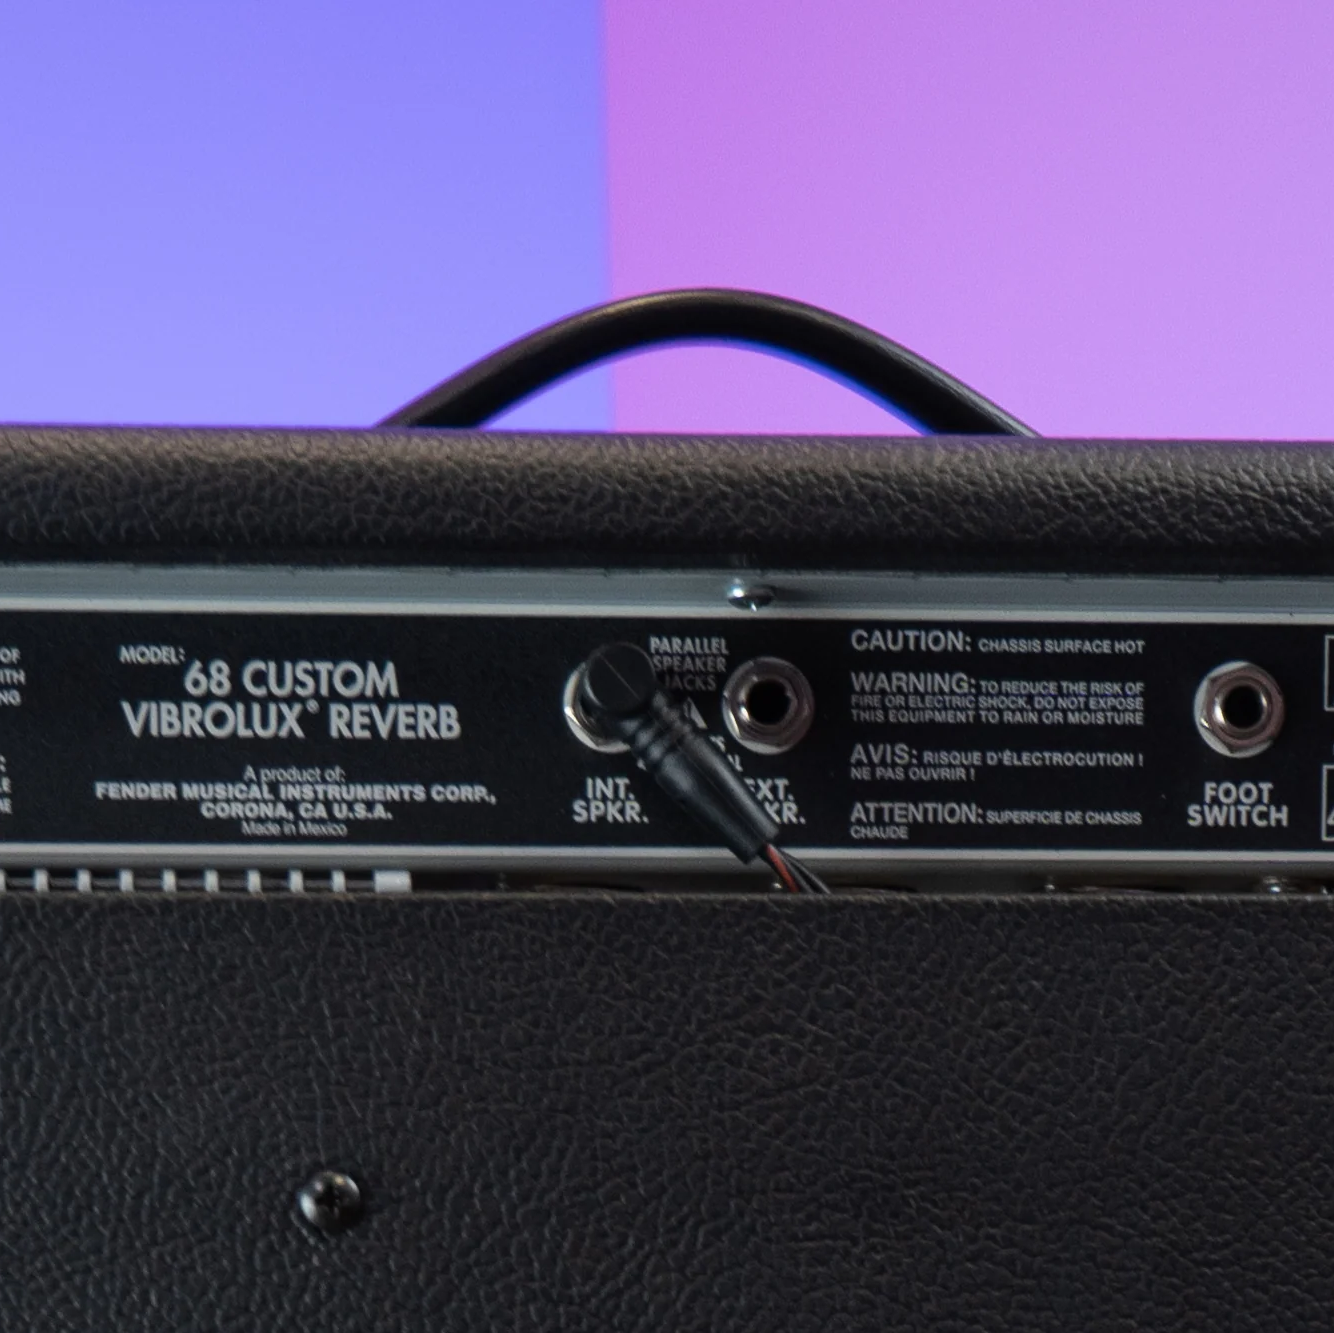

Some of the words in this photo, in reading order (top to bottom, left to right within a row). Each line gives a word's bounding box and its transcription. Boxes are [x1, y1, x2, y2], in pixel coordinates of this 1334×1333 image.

[649, 636, 728, 654] PARALLEL
[850, 629, 971, 652] CAUTION:
[978, 640, 1042, 653] CHASSIS
[1043, 640, 1112, 654] SURFACE
[1114, 641, 1145, 655] HOT
[119, 644, 186, 666] MODEL:
[651, 655, 727, 672] SPEAKER
[183, 660, 232, 698] 68
[242, 660, 400, 698] CUSTOM
[850, 671, 976, 694] WARNING:
[980, 681, 1000, 695] TO
[1001, 681, 1059, 695] REDUCE
[1060, 681, 1088, 695] THE
[1090, 681, 1123, 696] RISK
[1125, 682, 1145, 696] OF
[850, 694, 884, 708] FIRE
[885, 694, 906, 708] OR
[908, 695, 976, 709] ELECTRIC
[978, 695, 1032, 709] SHOCK,
[1034, 695, 1054, 709] DO
[1056, 696, 1087, 710] NOT
[1089, 696, 1144, 710] EXPOSE
[328, 701, 462, 739] REVERB
[850, 709, 885, 723] THIS
[886, 709, 976, 723] EQUIPMENT
[978, 709, 1000, 723] TO
[1003, 710, 1040, 724] RAIN
[1042, 710, 1064, 724] OR
[1066, 710, 1144, 724] MOISTURE
[850, 743, 918, 765] AVIS:
[923, 751, 982, 766] RISQUE
[243, 765, 258, 780] A
[259, 766, 318, 785] product
[324, 765, 348, 783] of:
[850, 767, 872, 780] NE
[875, 767, 905, 781] PAS
[908, 767, 966, 781] OUVRIR
[94, 781, 177, 800] FENDER
[181, 782, 274, 801] MUSICAL
[279, 784, 427, 803] INSTRUMENTS
[586, 776, 635, 800] INT.
[1204, 781, 1274, 804] FOOT
[200, 802, 294, 820] CORONA,
[299, 803, 328, 821] CA
[334, 803, 394, 821] U.S.A.
[571, 800, 650, 824] SPKR.
[850, 802, 984, 824] ATTENTION:
[1064, 810, 1083, 825] DE
[1085, 811, 1143, 826] CHASSIS
[1187, 803, 1289, 828] SWITCH
[241, 820, 281, 836] Made
[283, 820, 296, 836] in
[299, 821, 348, 837] Mexico
[850, 825, 909, 839] CHAUDE
